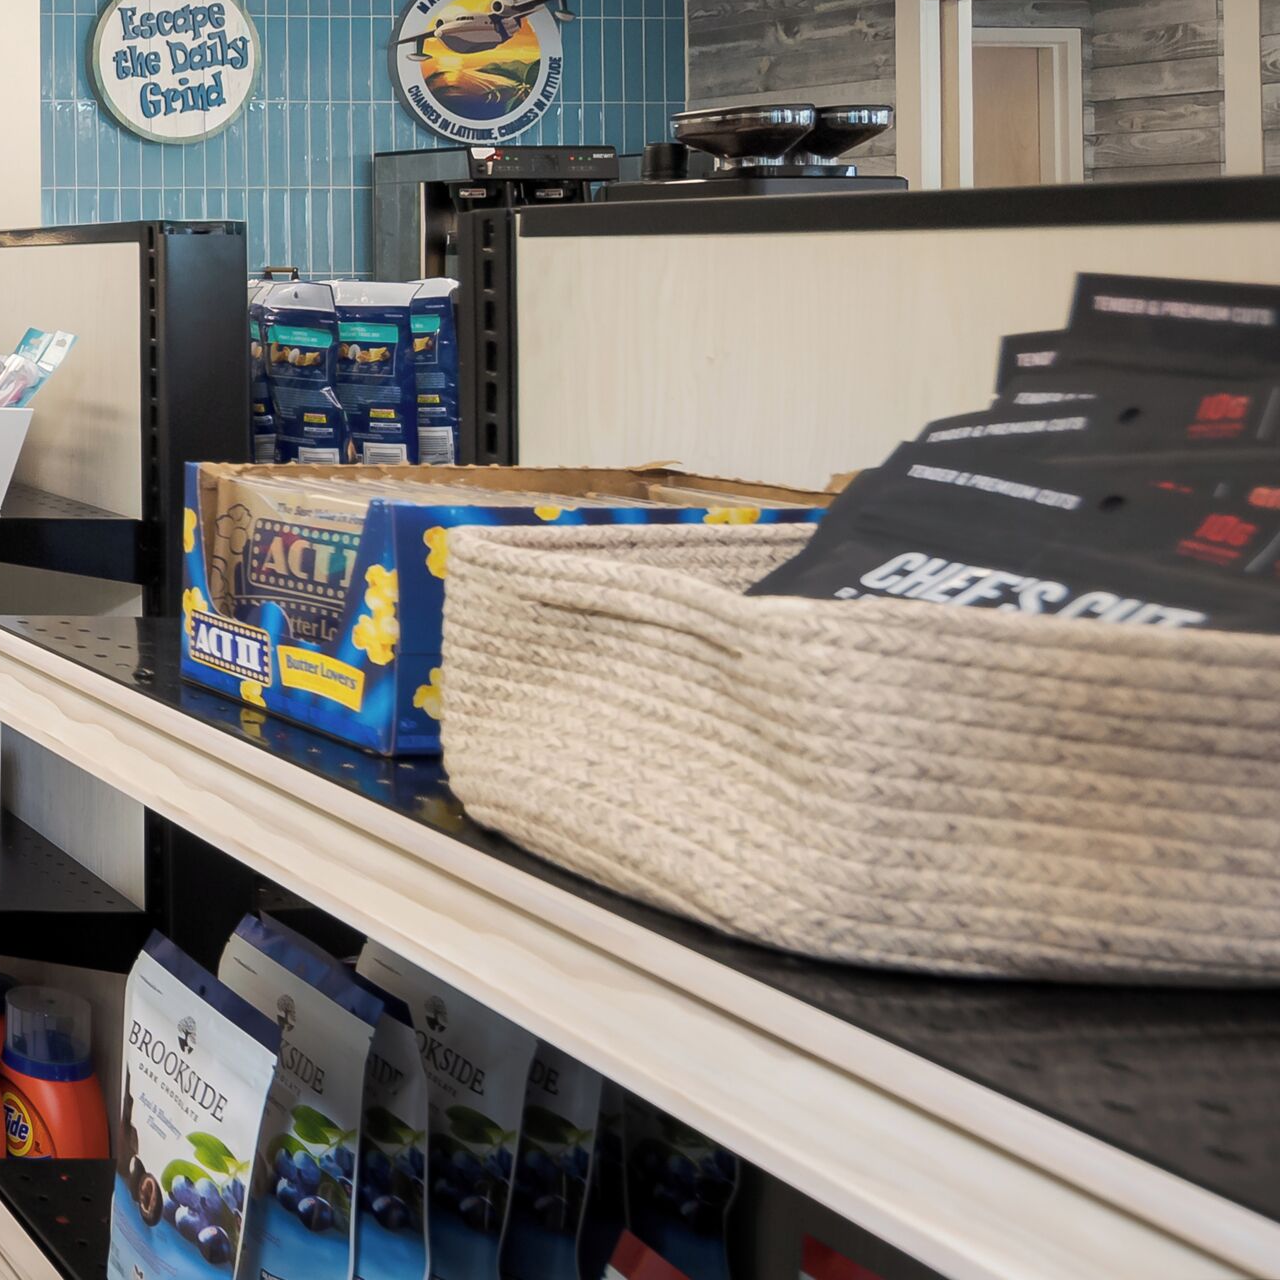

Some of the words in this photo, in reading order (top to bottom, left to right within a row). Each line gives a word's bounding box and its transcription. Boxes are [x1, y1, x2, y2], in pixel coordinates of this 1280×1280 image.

[117, 2, 226, 41] Escape
[112, 45, 162, 81] the
[165, 29, 251, 75] Daily
[139, 70, 227, 119] Grind
[407, 84, 441, 127] CHANGES
[539, 56, 563, 102] ATTITUDE
[261, 535, 337, 585] ACT
[859, 551, 1069, 615] CHEF'S
[195, 623, 234, 662] ACT
[235, 635, 262, 672] II
[286, 654, 319, 677] Butter
[320, 663, 359, 691] Lovers
[128, 1019, 229, 1123] BROOKSIDE
[138, 1062, 158, 1084] DARK
[160, 1082, 200, 1123] CHOCOLATE
[3, 1104, 30, 1142] Tide
